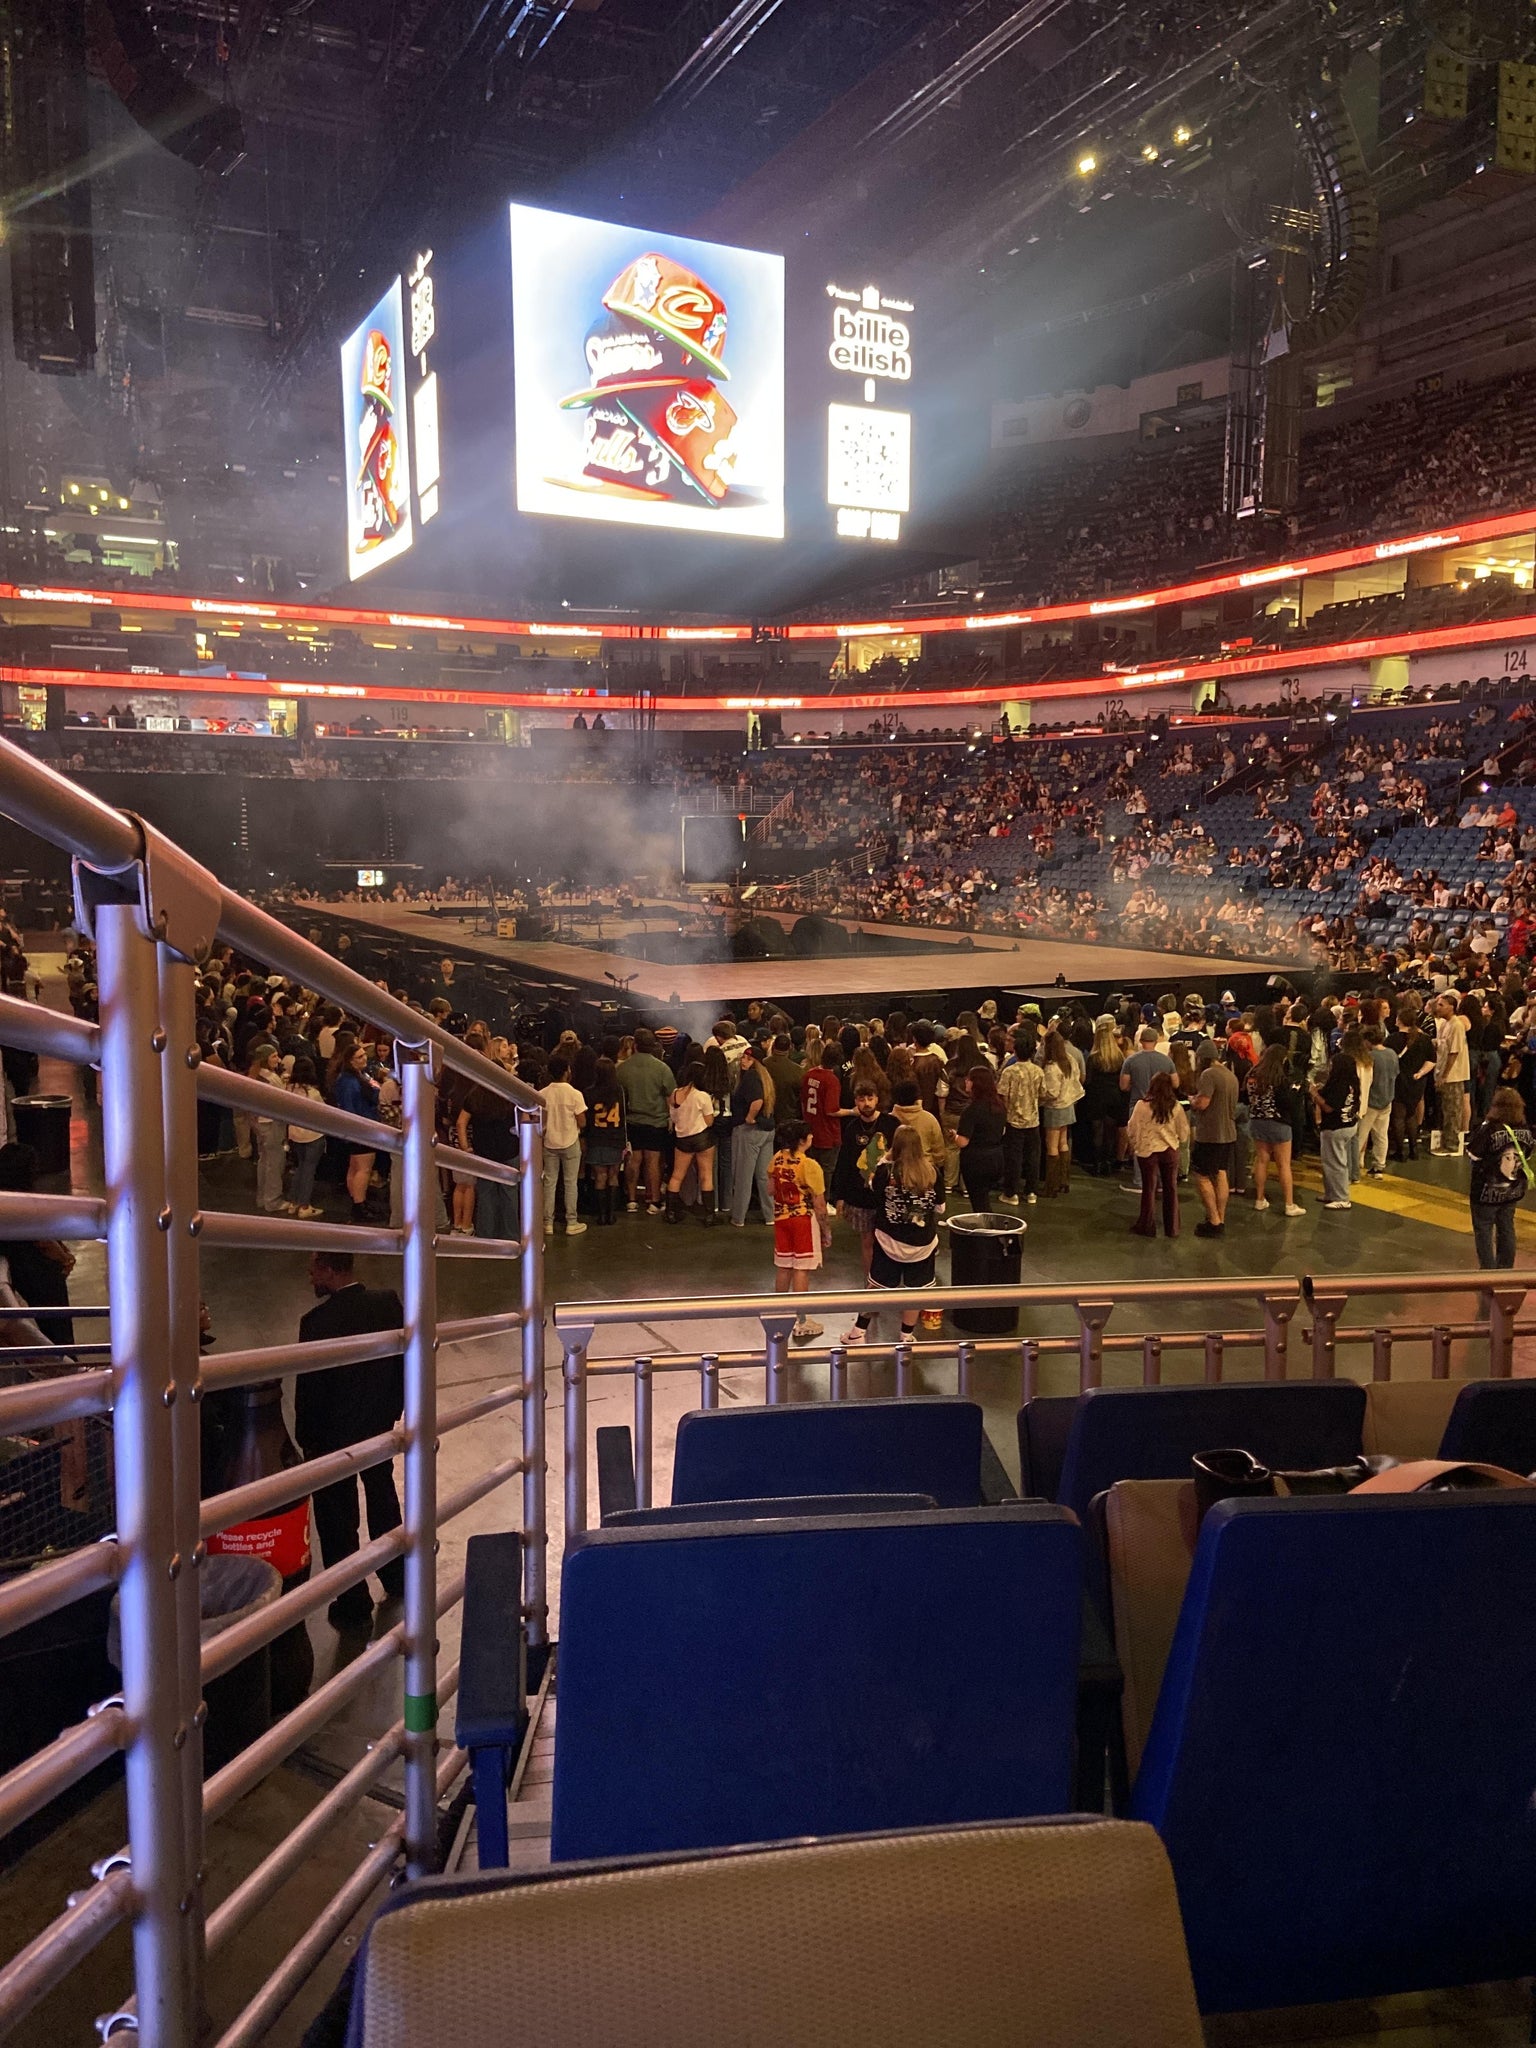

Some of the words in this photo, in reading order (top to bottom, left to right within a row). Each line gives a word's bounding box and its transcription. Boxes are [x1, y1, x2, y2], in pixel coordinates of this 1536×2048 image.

[839, 314, 904, 346] billie
[834, 345, 906, 374] eilish
[1504, 650, 1527, 672] 124
[883, 712, 899, 727] 121
[594, 1102, 620, 1128] 24
[222, 1541, 254, 1551] bottles
[256, 1538, 275, 1550] and
[246, 1528, 282, 1541] recycle
